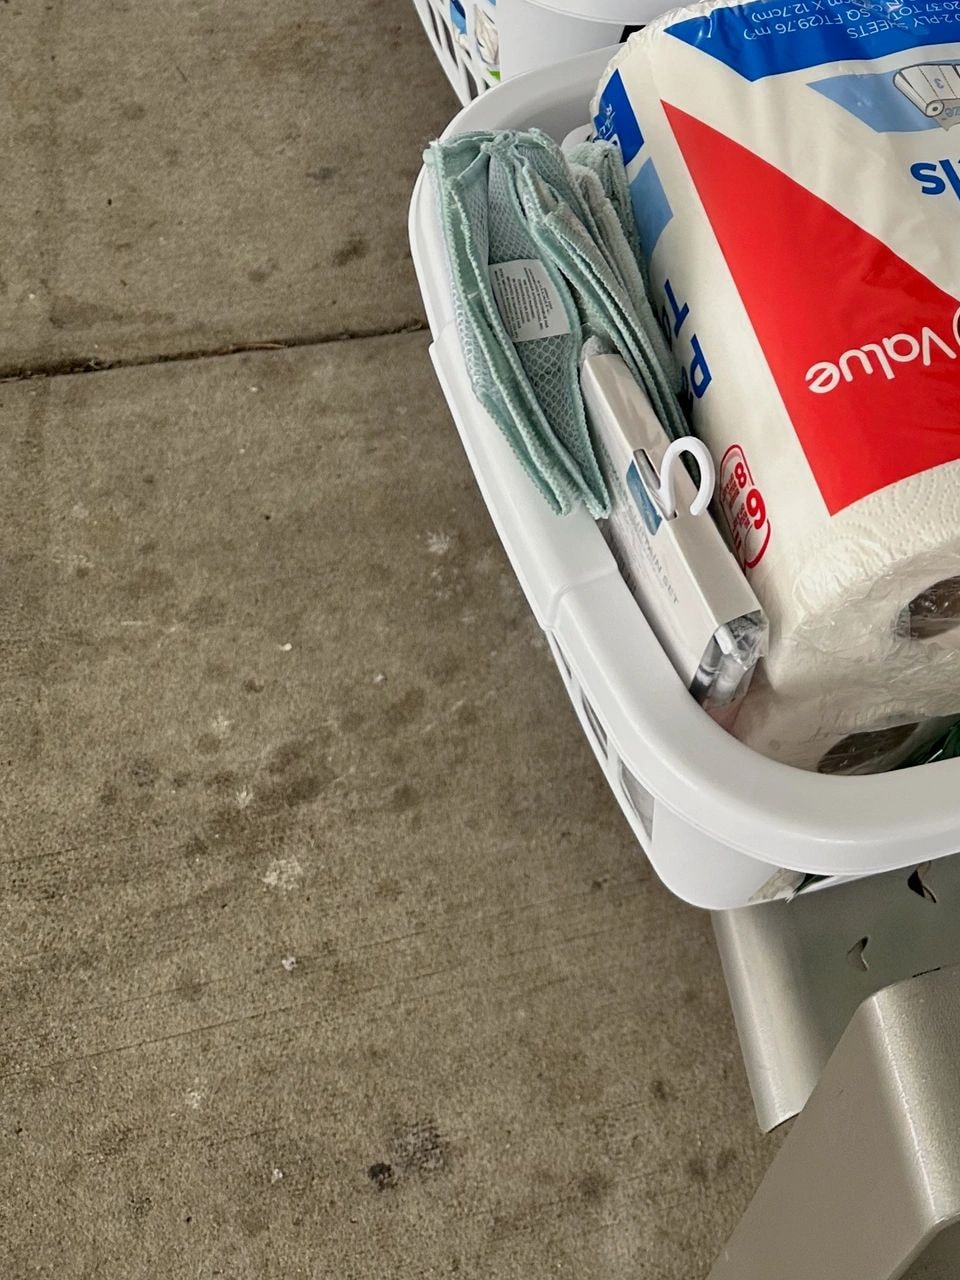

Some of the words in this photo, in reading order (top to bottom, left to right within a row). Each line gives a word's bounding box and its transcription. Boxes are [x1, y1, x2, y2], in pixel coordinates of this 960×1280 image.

[750, 1, 808, 24] 12.7cm)
[844, 6, 871, 22] SQ
[912, 12, 953, 27] 2-PLY
[933, 77, 943, 89] 3
[805, 328, 957, 394] Value
[734, 462, 748, 487] 8
